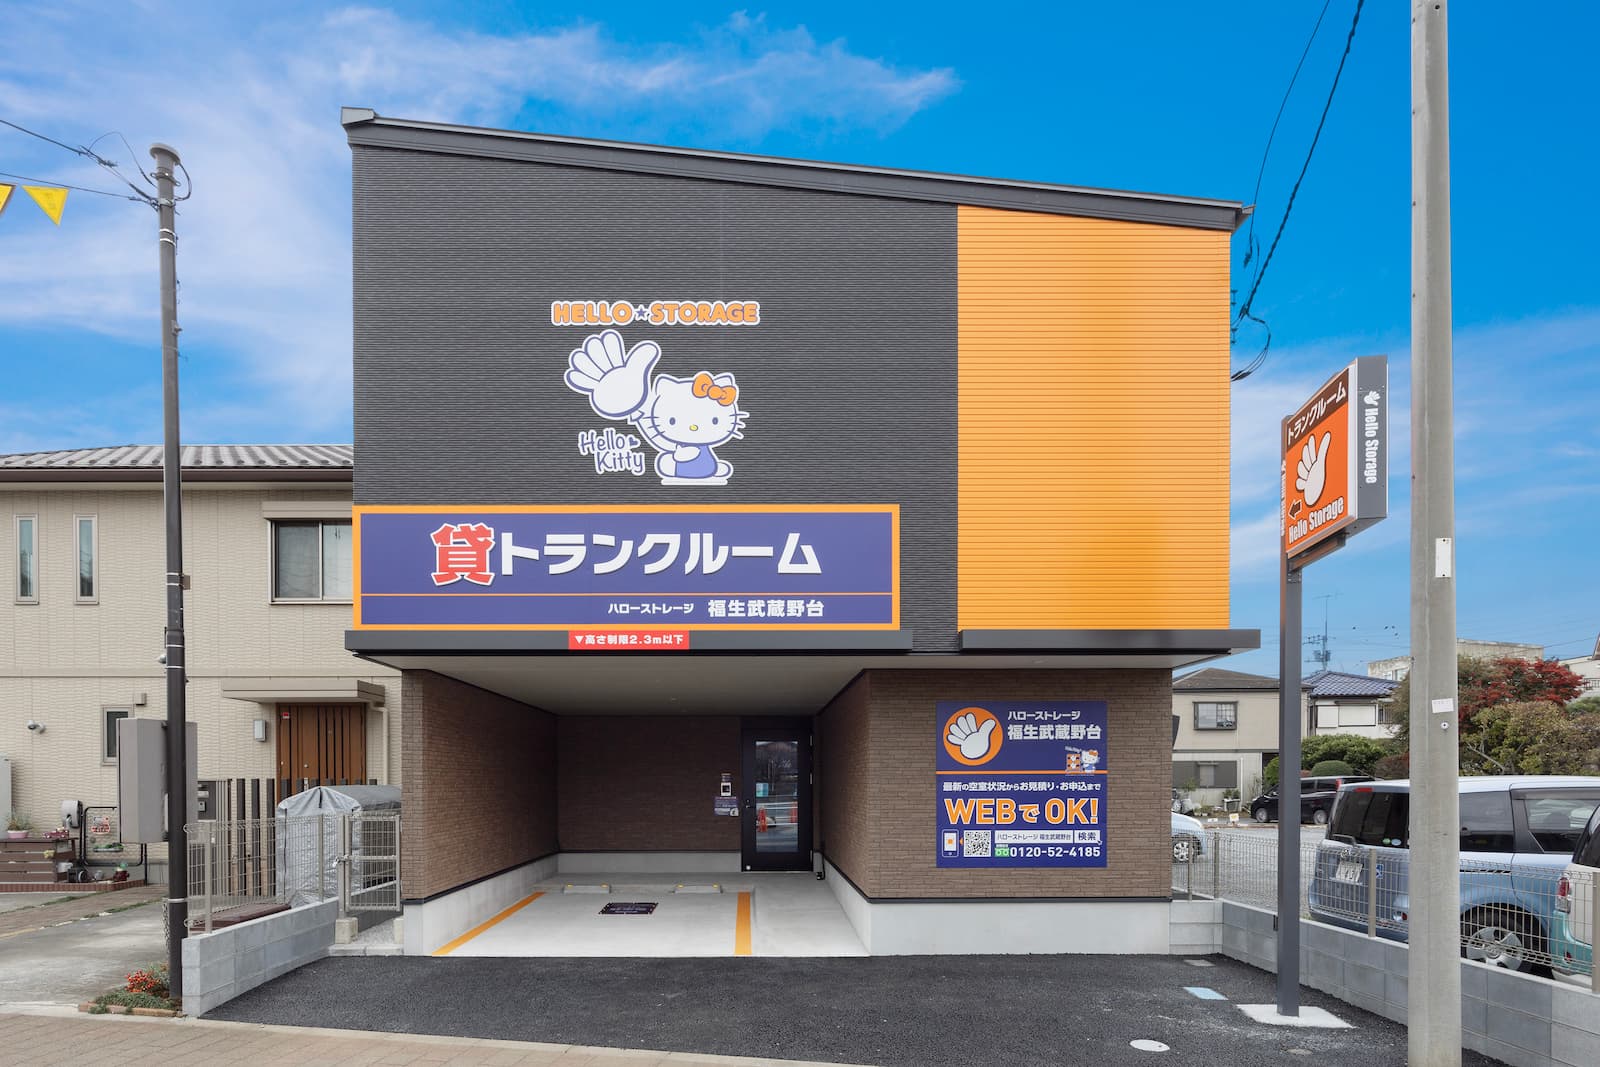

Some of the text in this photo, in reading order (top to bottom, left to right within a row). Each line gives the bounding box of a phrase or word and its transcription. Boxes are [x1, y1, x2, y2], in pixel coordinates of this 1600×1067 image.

[551, 300, 761, 326] HELLO STORAGE
[1287, 381, 1347, 446] トランクルーム
[578, 427, 627, 455] Hello
[1364, 408, 1380, 484] Hello Storage
[595, 451, 645, 475] Kitty
[1288, 516, 1308, 545] Hello
[1308, 496, 1345, 536] Storage
[430, 521, 822, 587] 貸トランクルーム
[607, 599, 825, 618] ハローストレージ 福生武蔵野台
[1007, 710, 1081, 721] ハローストレージ
[1007, 724, 1102, 740] 福生武蔵野台
[1078, 831, 1097, 841] 検索
[1010, 846, 1101, 858] 0120-52-4185
